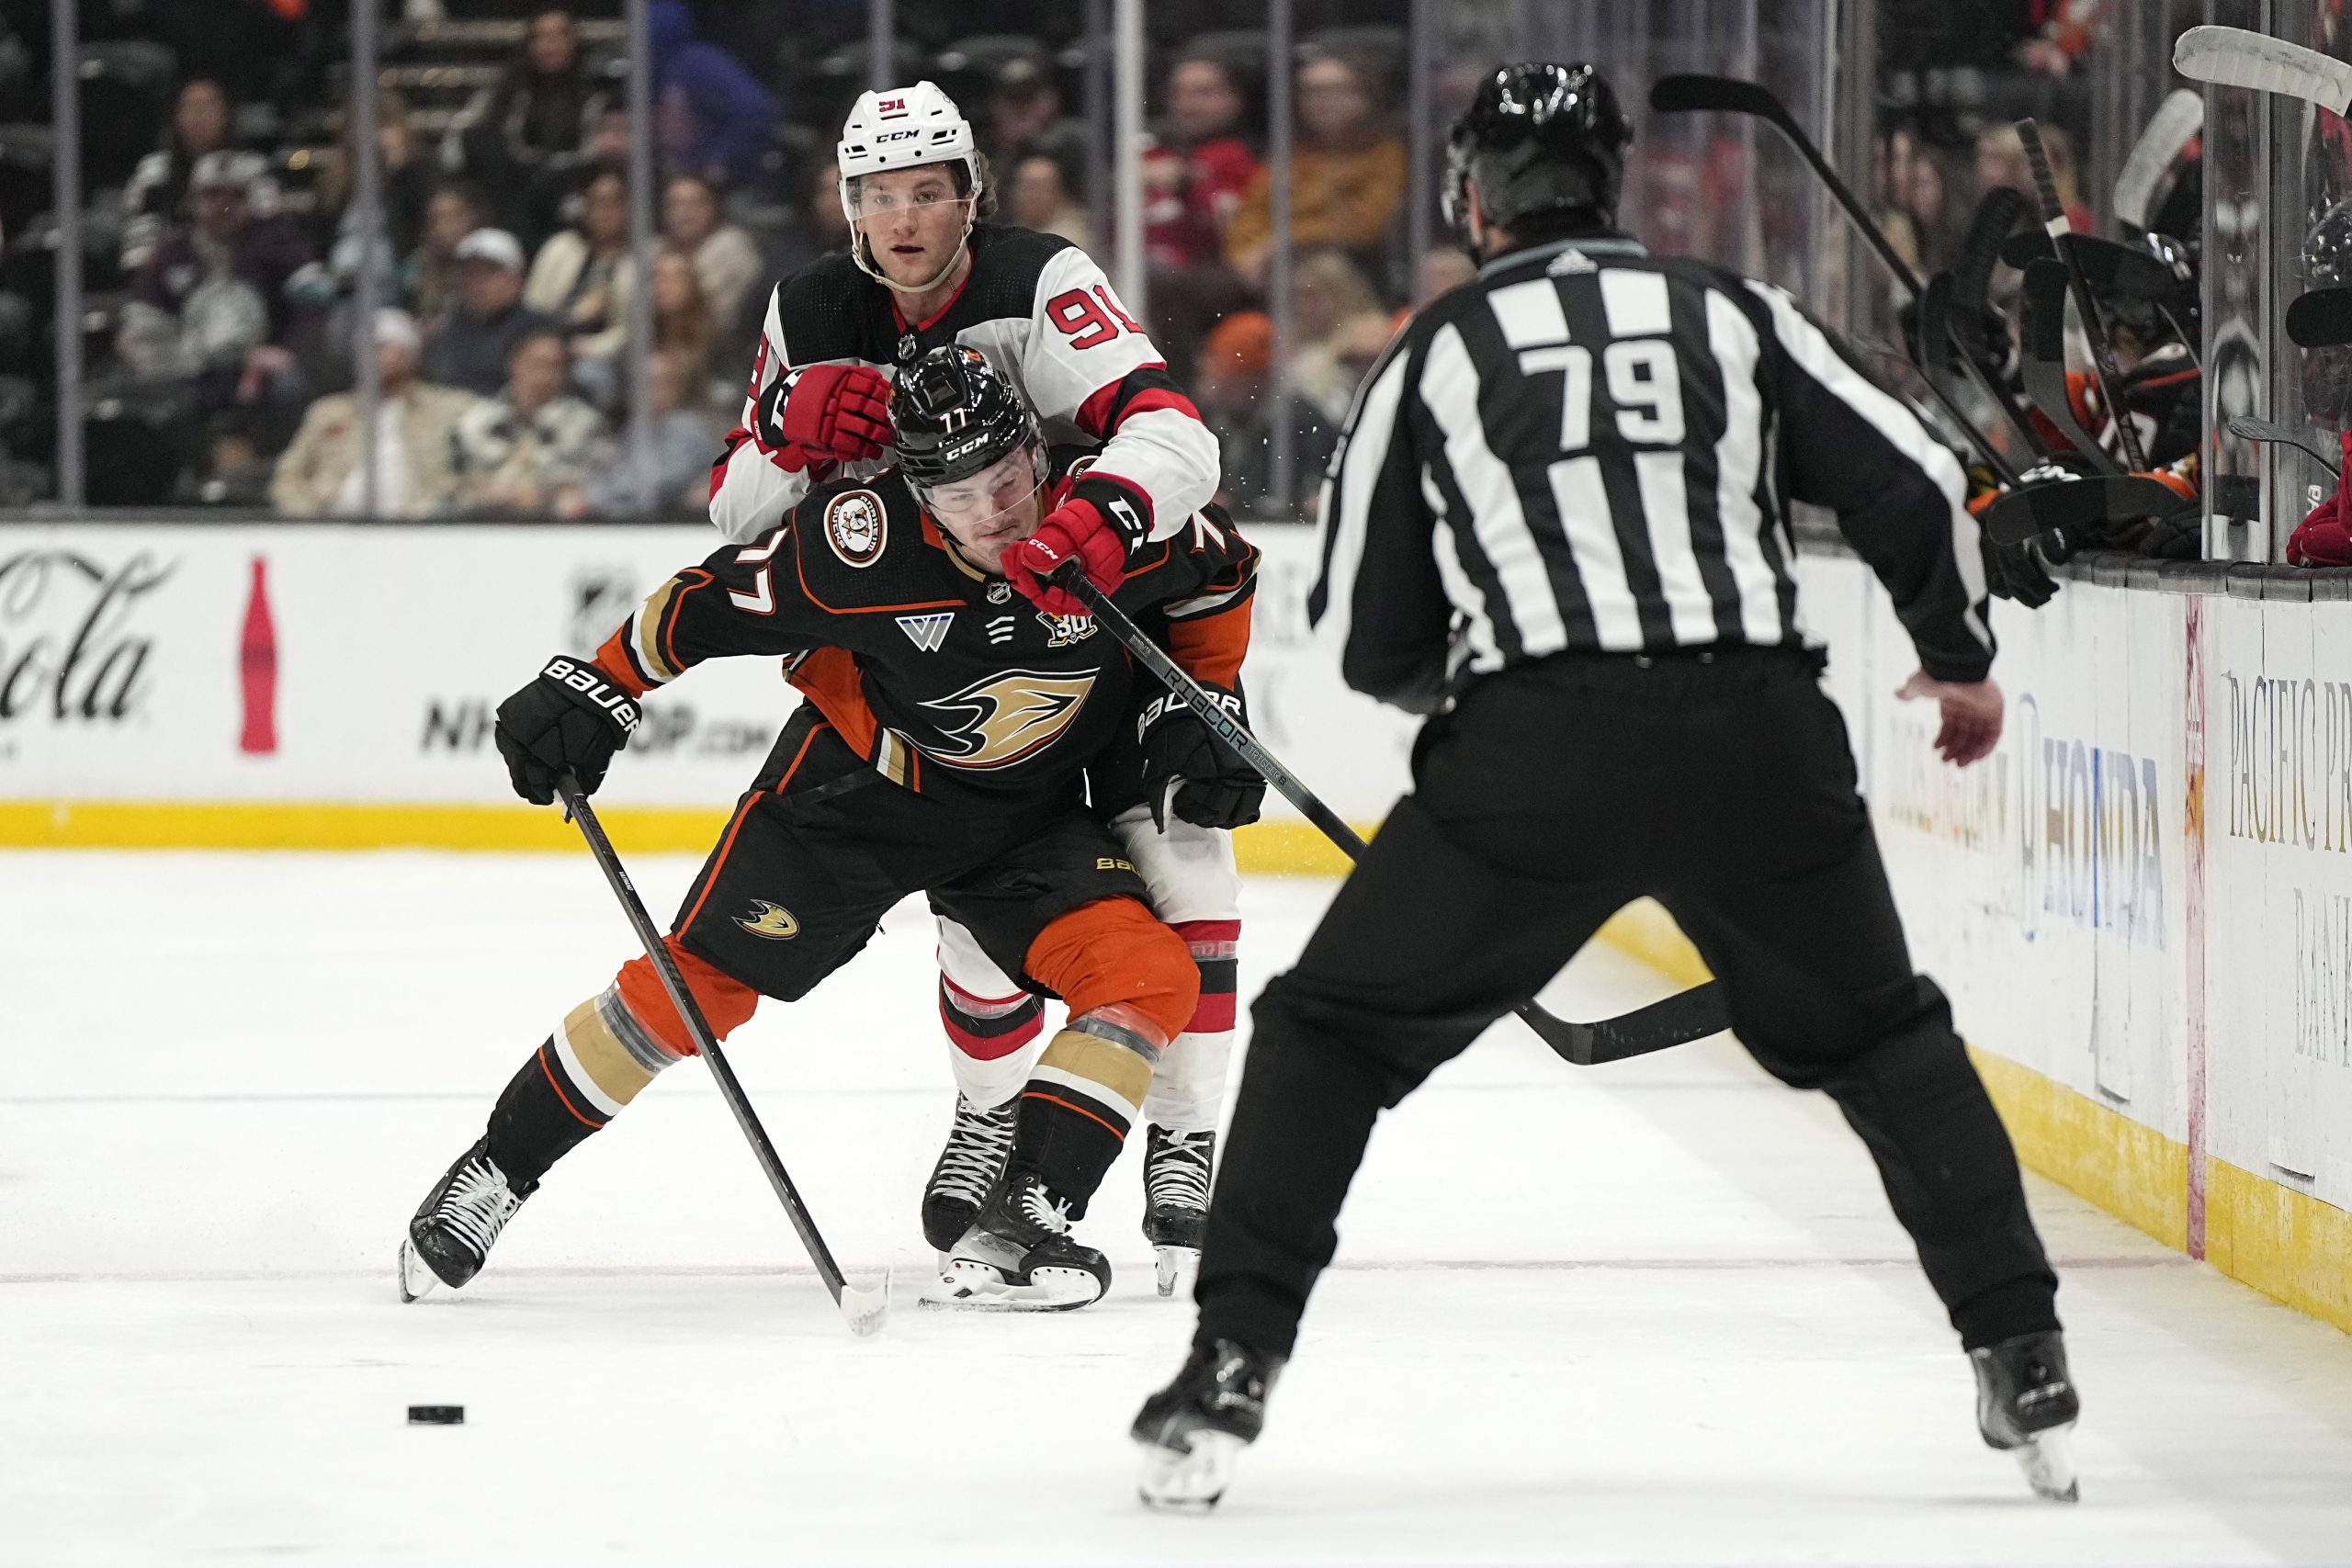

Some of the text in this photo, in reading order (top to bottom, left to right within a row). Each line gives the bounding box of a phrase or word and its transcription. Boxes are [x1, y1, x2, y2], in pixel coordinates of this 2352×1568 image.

[876, 130, 920, 143] CCM
[1046, 284, 1147, 350] 91
[939, 407, 966, 434] 77
[1519, 338, 1685, 451] 79
[946, 433, 989, 461] CCM
[1028, 538, 1059, 560] CCM
[1163, 667, 1249, 750] RIBCOR
[2229, 675, 2316, 852] PACIFIC
[2042, 736, 2167, 953] HONDA
